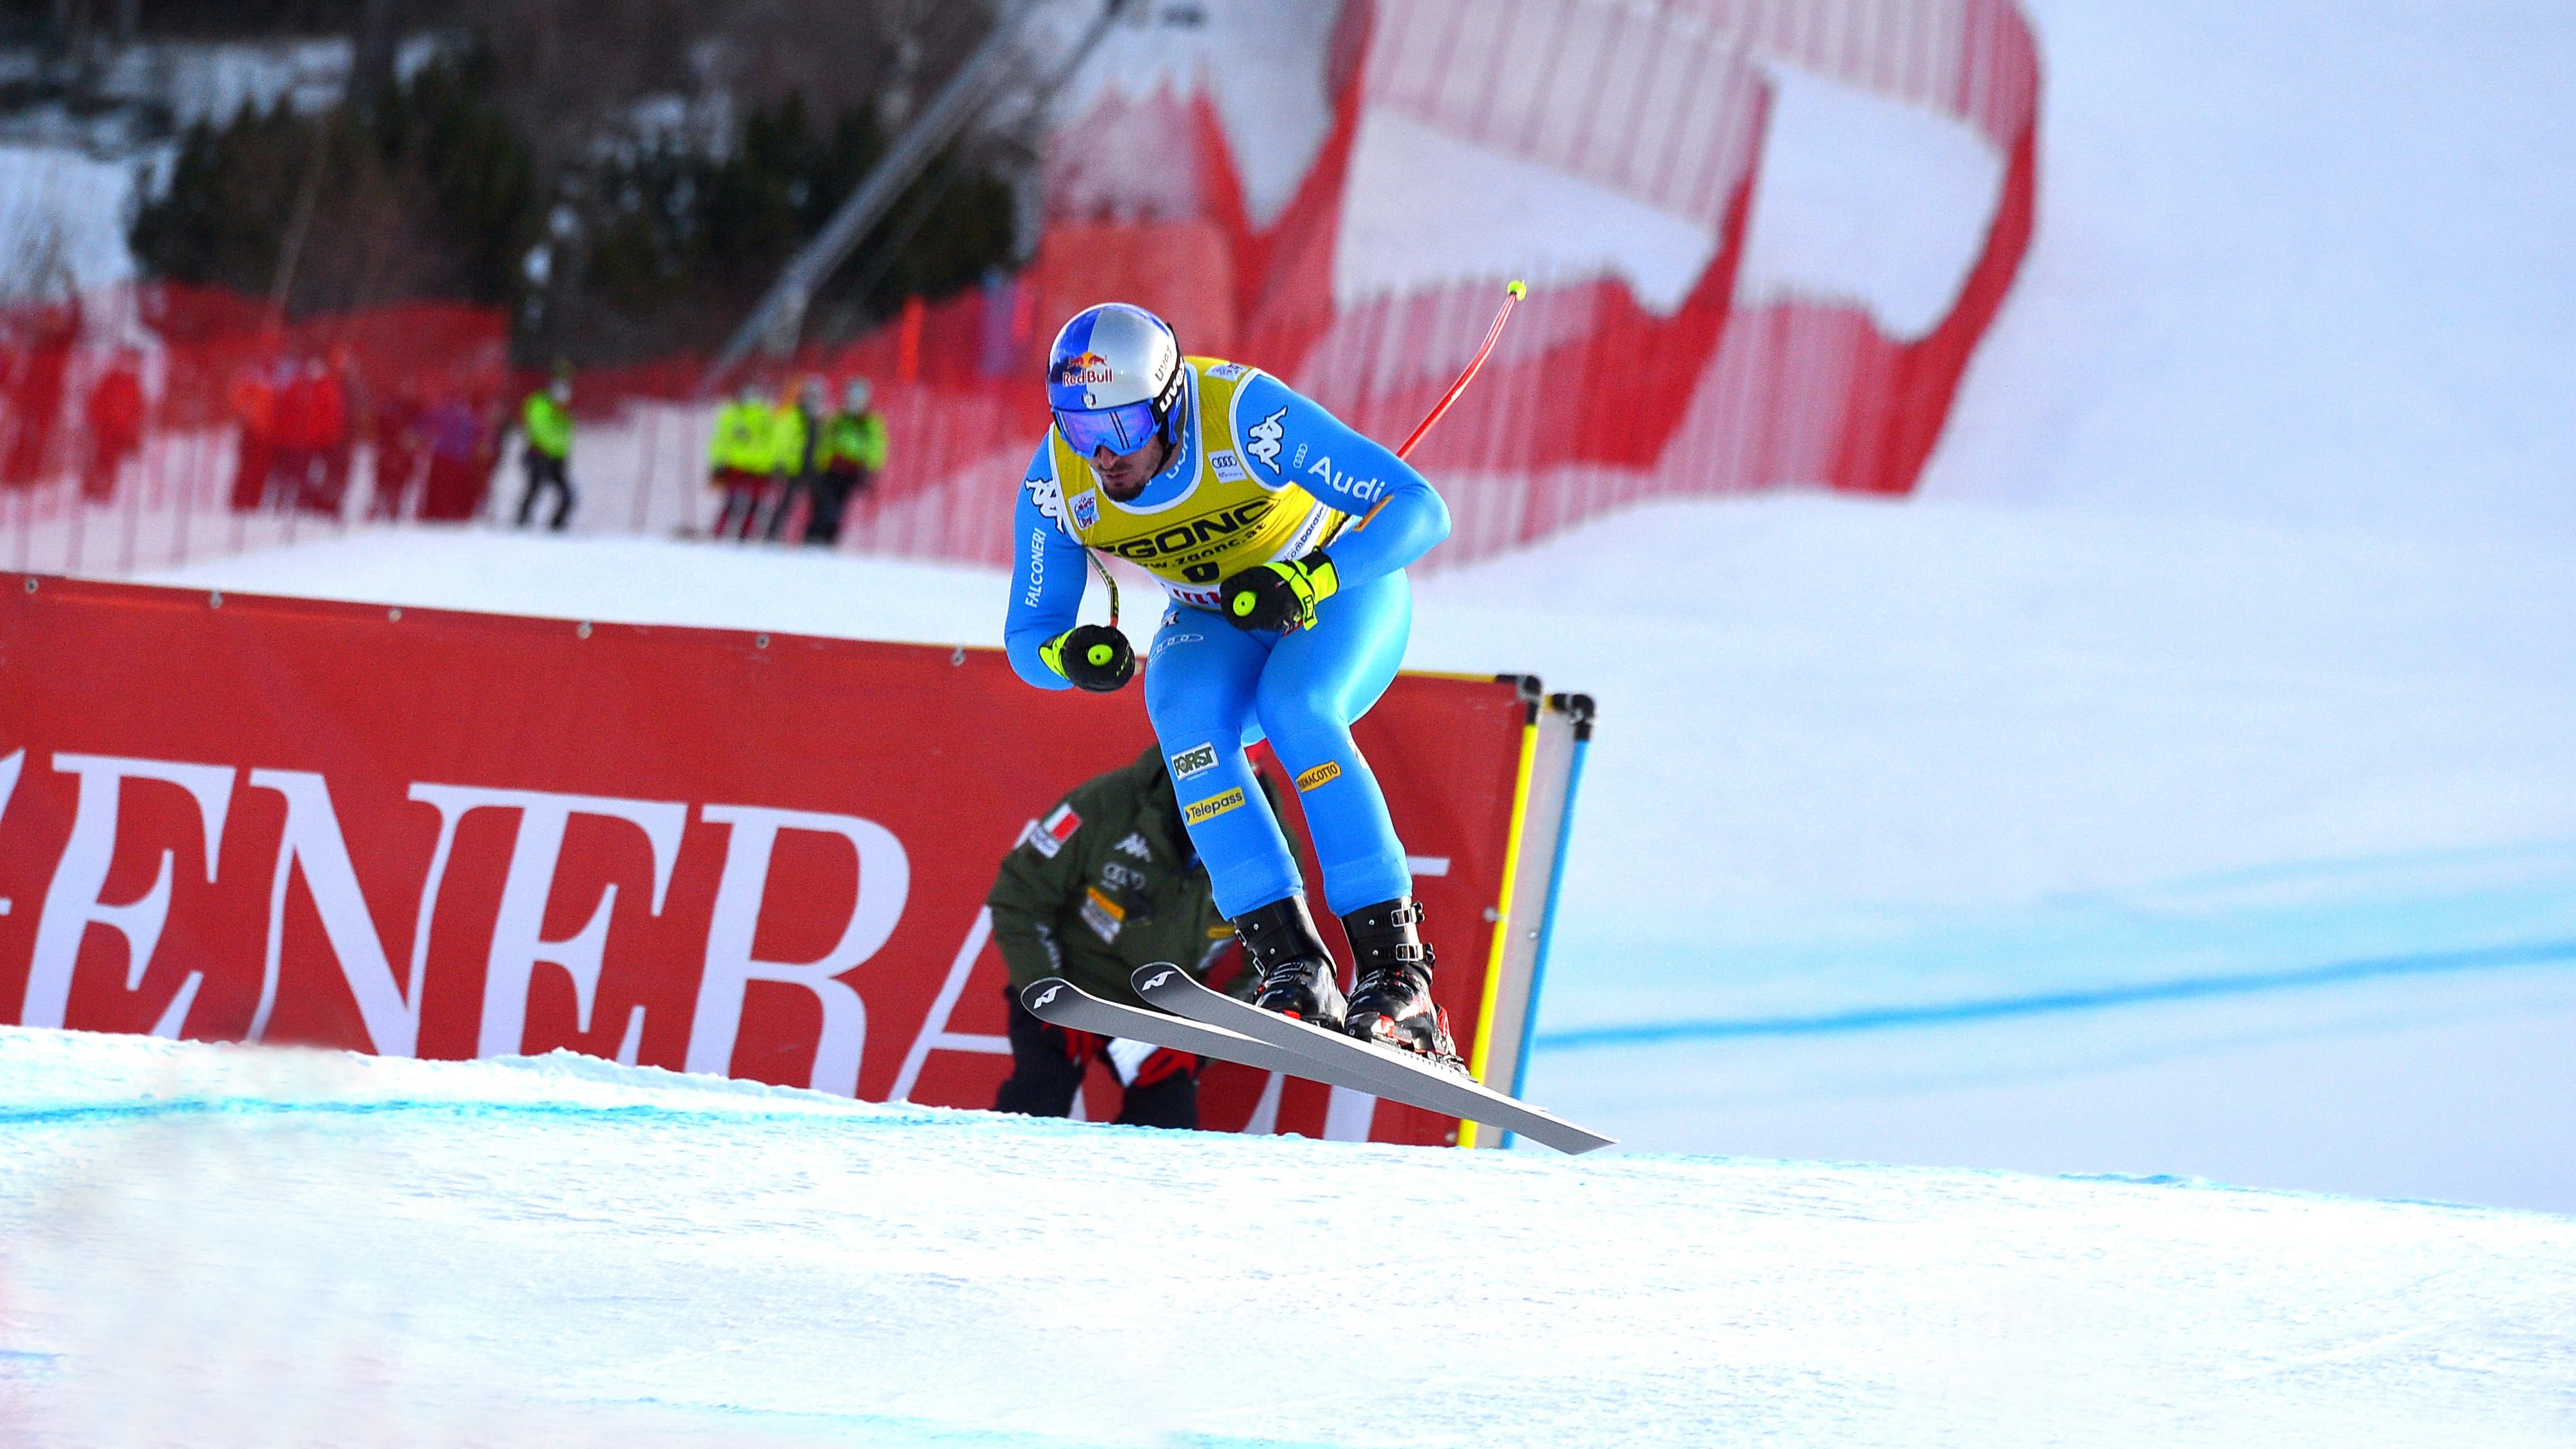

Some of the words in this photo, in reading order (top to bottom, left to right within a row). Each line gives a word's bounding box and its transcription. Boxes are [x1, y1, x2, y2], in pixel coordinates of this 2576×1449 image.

[1063, 369, 1085, 386] Red
[1087, 369, 1113, 383] Bull
[1160, 357, 1185, 412] uvex
[1308, 456, 1386, 503] Audi
[1025, 527, 1046, 607] FALCONERI
[1173, 747, 1214, 776] FORST
[1190, 789, 1243, 819] Telepass
